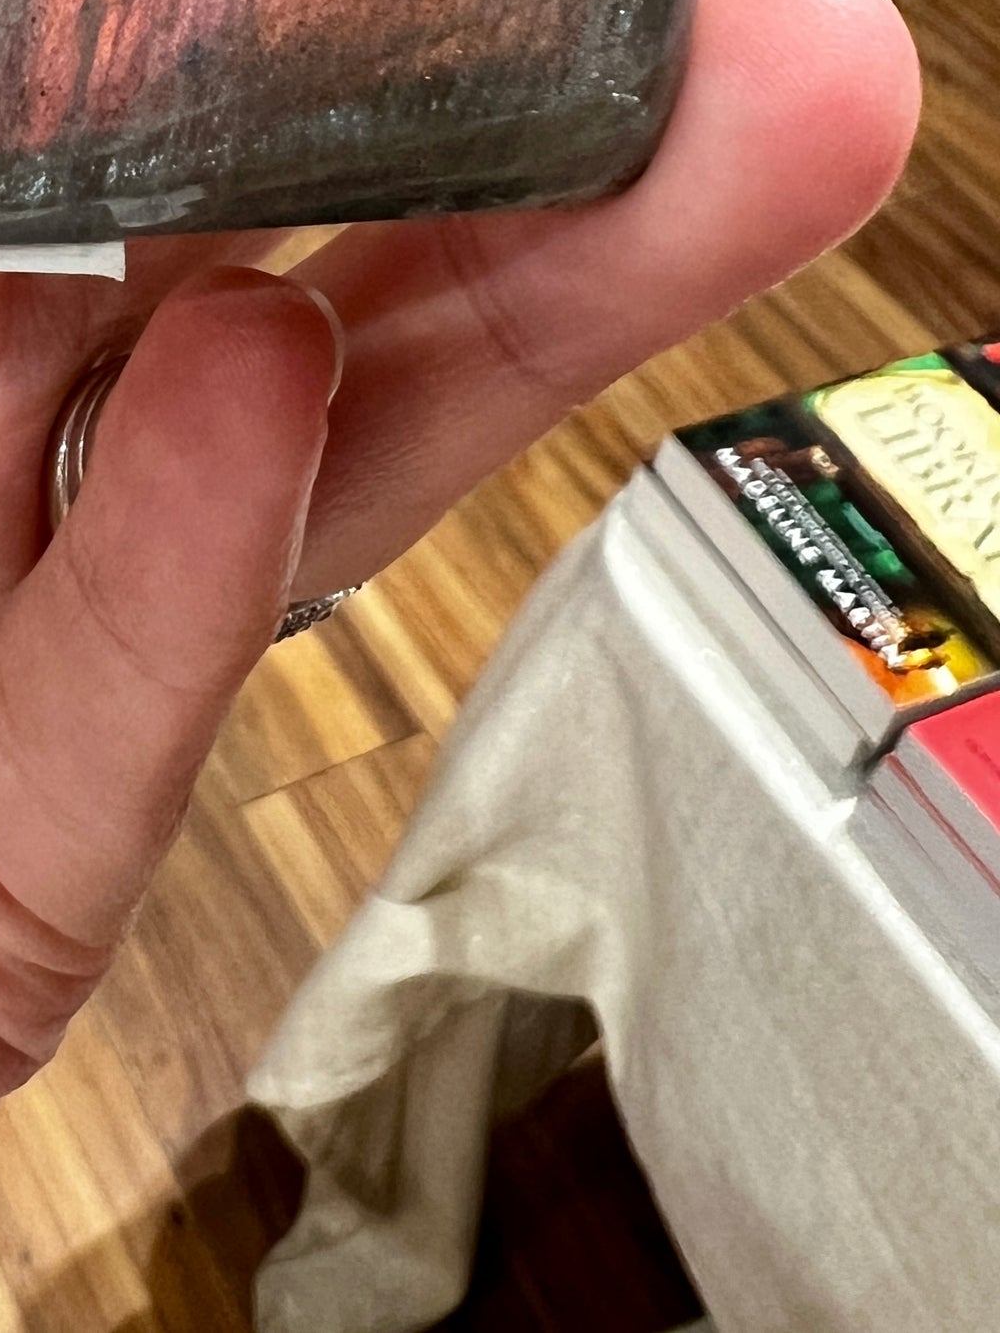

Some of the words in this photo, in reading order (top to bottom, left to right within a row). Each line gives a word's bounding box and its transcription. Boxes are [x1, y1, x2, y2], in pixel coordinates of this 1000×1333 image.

[715, 446, 823, 566] MADELINE
[815, 568, 909, 670] MARTIN
[857, 402, 1000, 562] LIBRA
